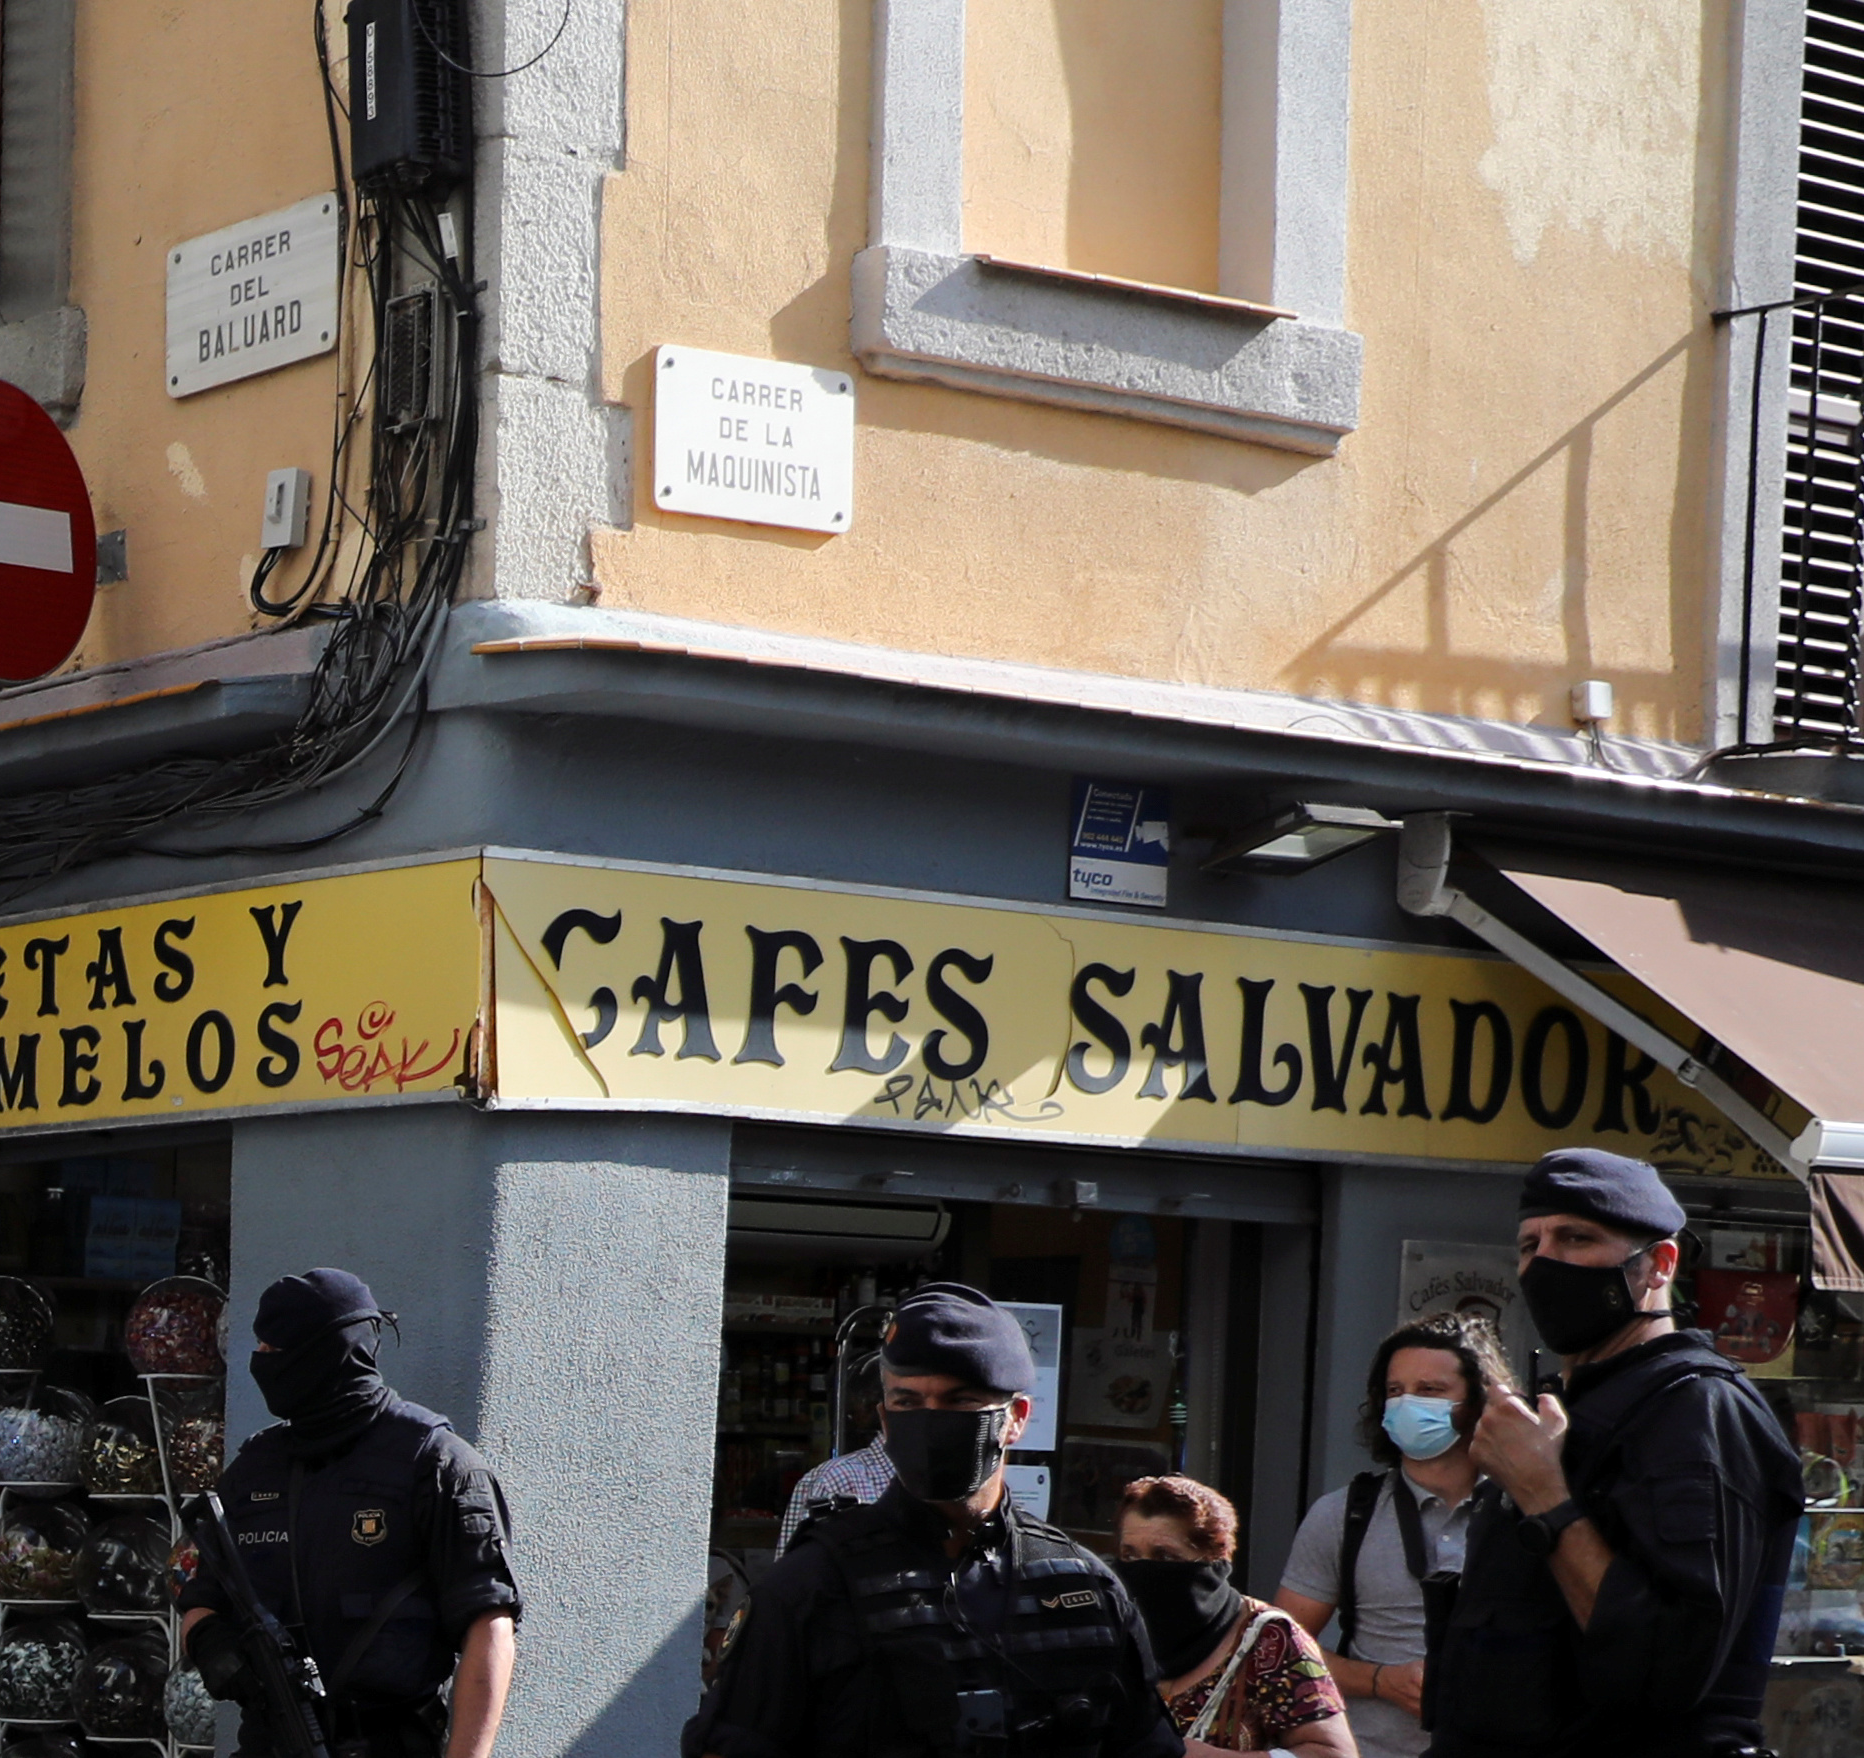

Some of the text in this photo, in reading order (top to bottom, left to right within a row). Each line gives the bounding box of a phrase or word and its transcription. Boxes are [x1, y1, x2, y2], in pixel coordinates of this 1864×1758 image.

[211, 230, 291, 276] CARRER
[230, 276, 269, 306] DEL
[199, 300, 301, 363] BALUARD
[711, 377, 803, 412] CARRER
[719, 416, 793, 448] DE LA
[687, 449, 821, 501] MAQUINISTA
[1073, 868, 1113, 888] tyco
[249, 900, 304, 988] Y
[541, 908, 1661, 1135] CAFES SALVADOR
[1454, 1271, 1517, 1305] Salvador
[238, 1530, 289, 1546] POLICIA
